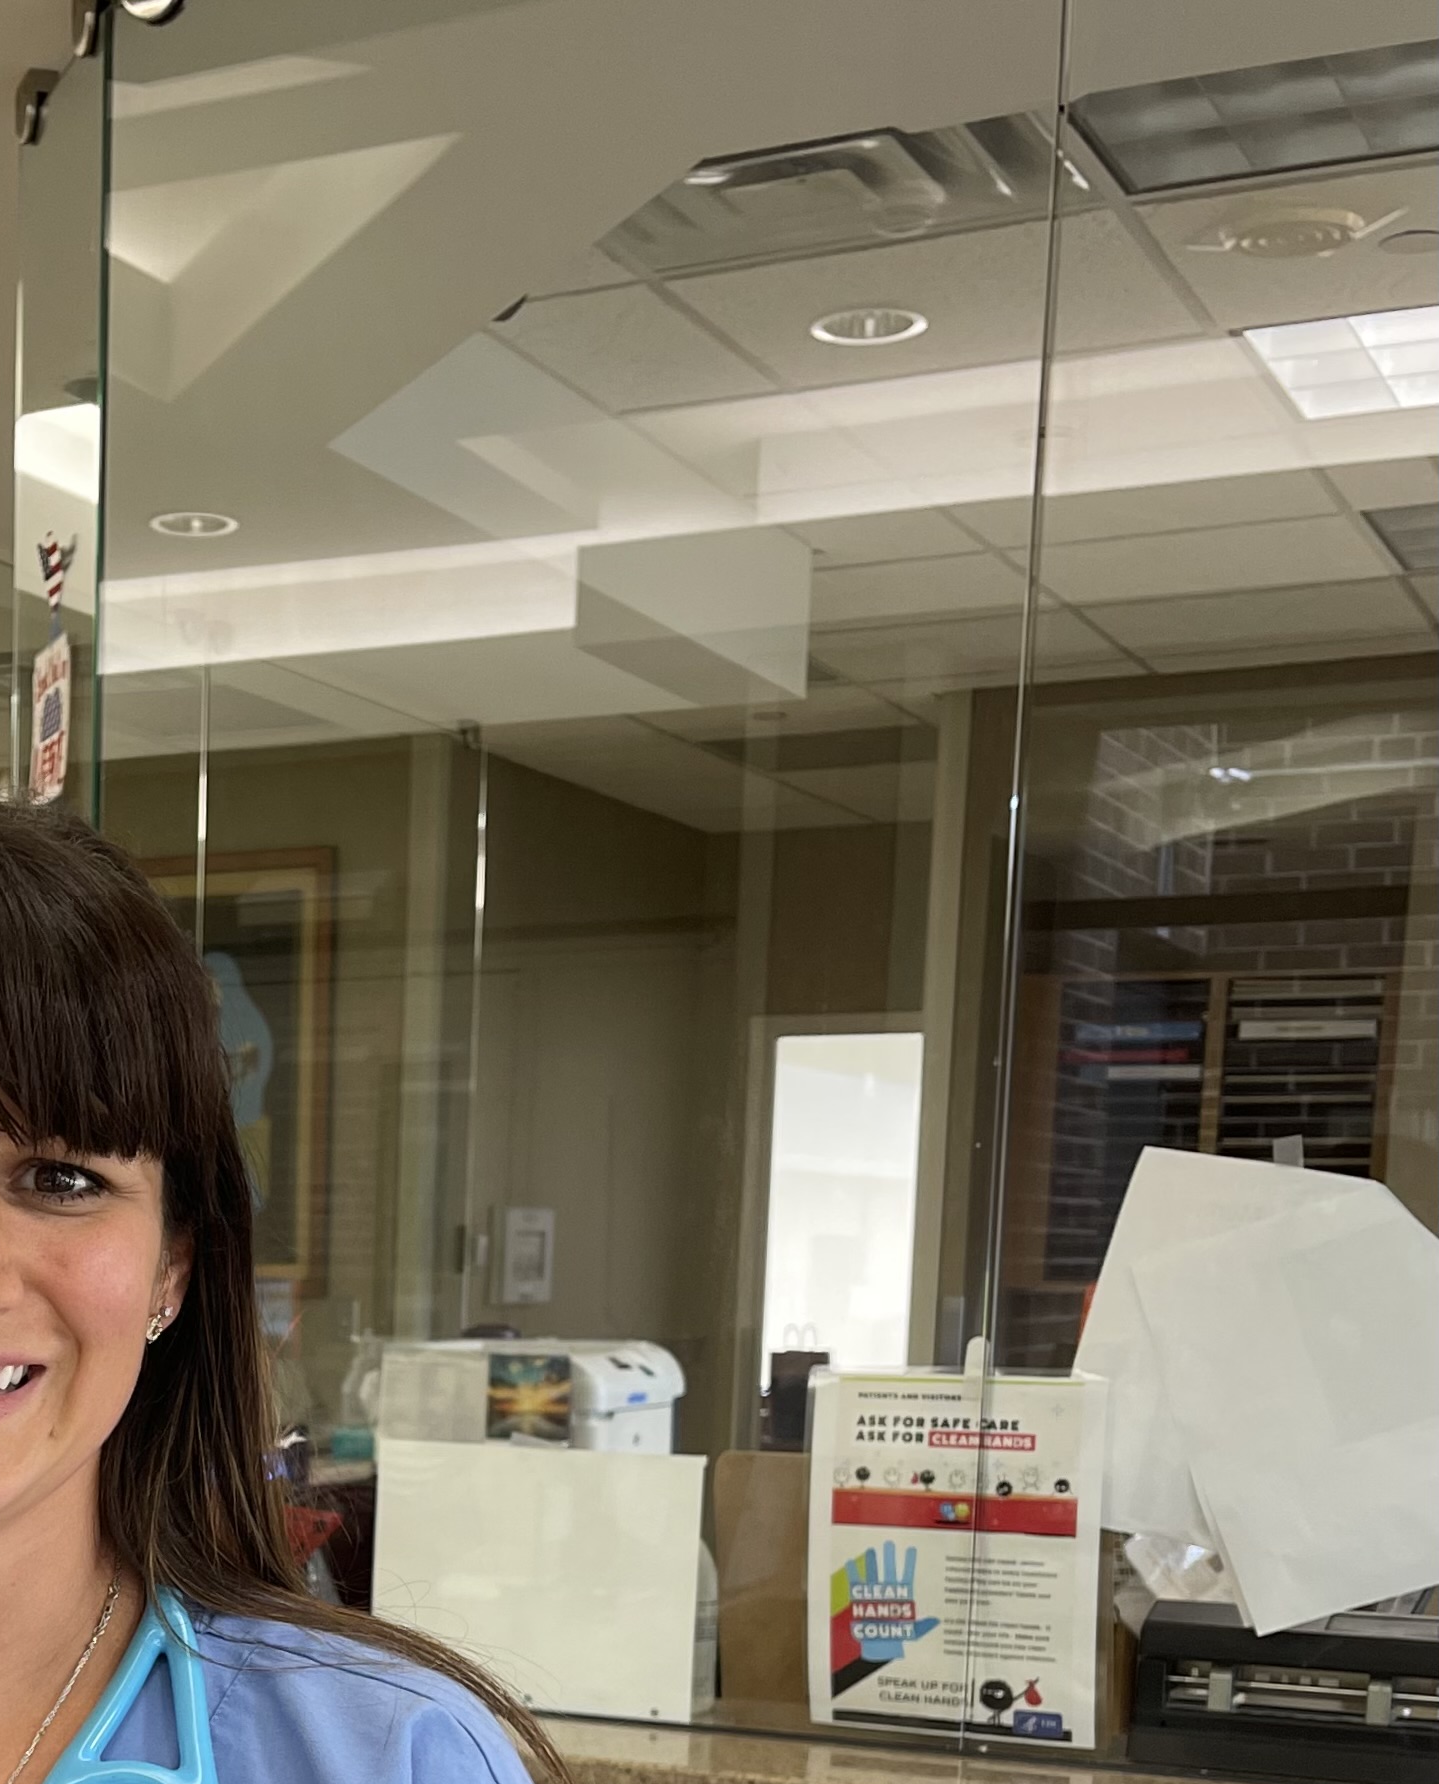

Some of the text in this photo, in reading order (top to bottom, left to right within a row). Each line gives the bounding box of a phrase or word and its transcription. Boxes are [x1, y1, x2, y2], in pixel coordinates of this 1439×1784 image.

[856, 1414, 1020, 1431] ASK FOR SAFE CARE
[855, 1429, 886, 1442] ASK
[892, 1431, 924, 1443] FOR
[931, 1433, 979, 1446] CLEAN
[851, 1584, 908, 1599] CLEAN
[852, 1603, 912, 1618] HANDS
[853, 1624, 914, 1639] COUNT
[877, 1676, 917, 1689] SPEAK
[921, 1678, 939, 1690] UP
[878, 1690, 921, 1704] CLEAN
